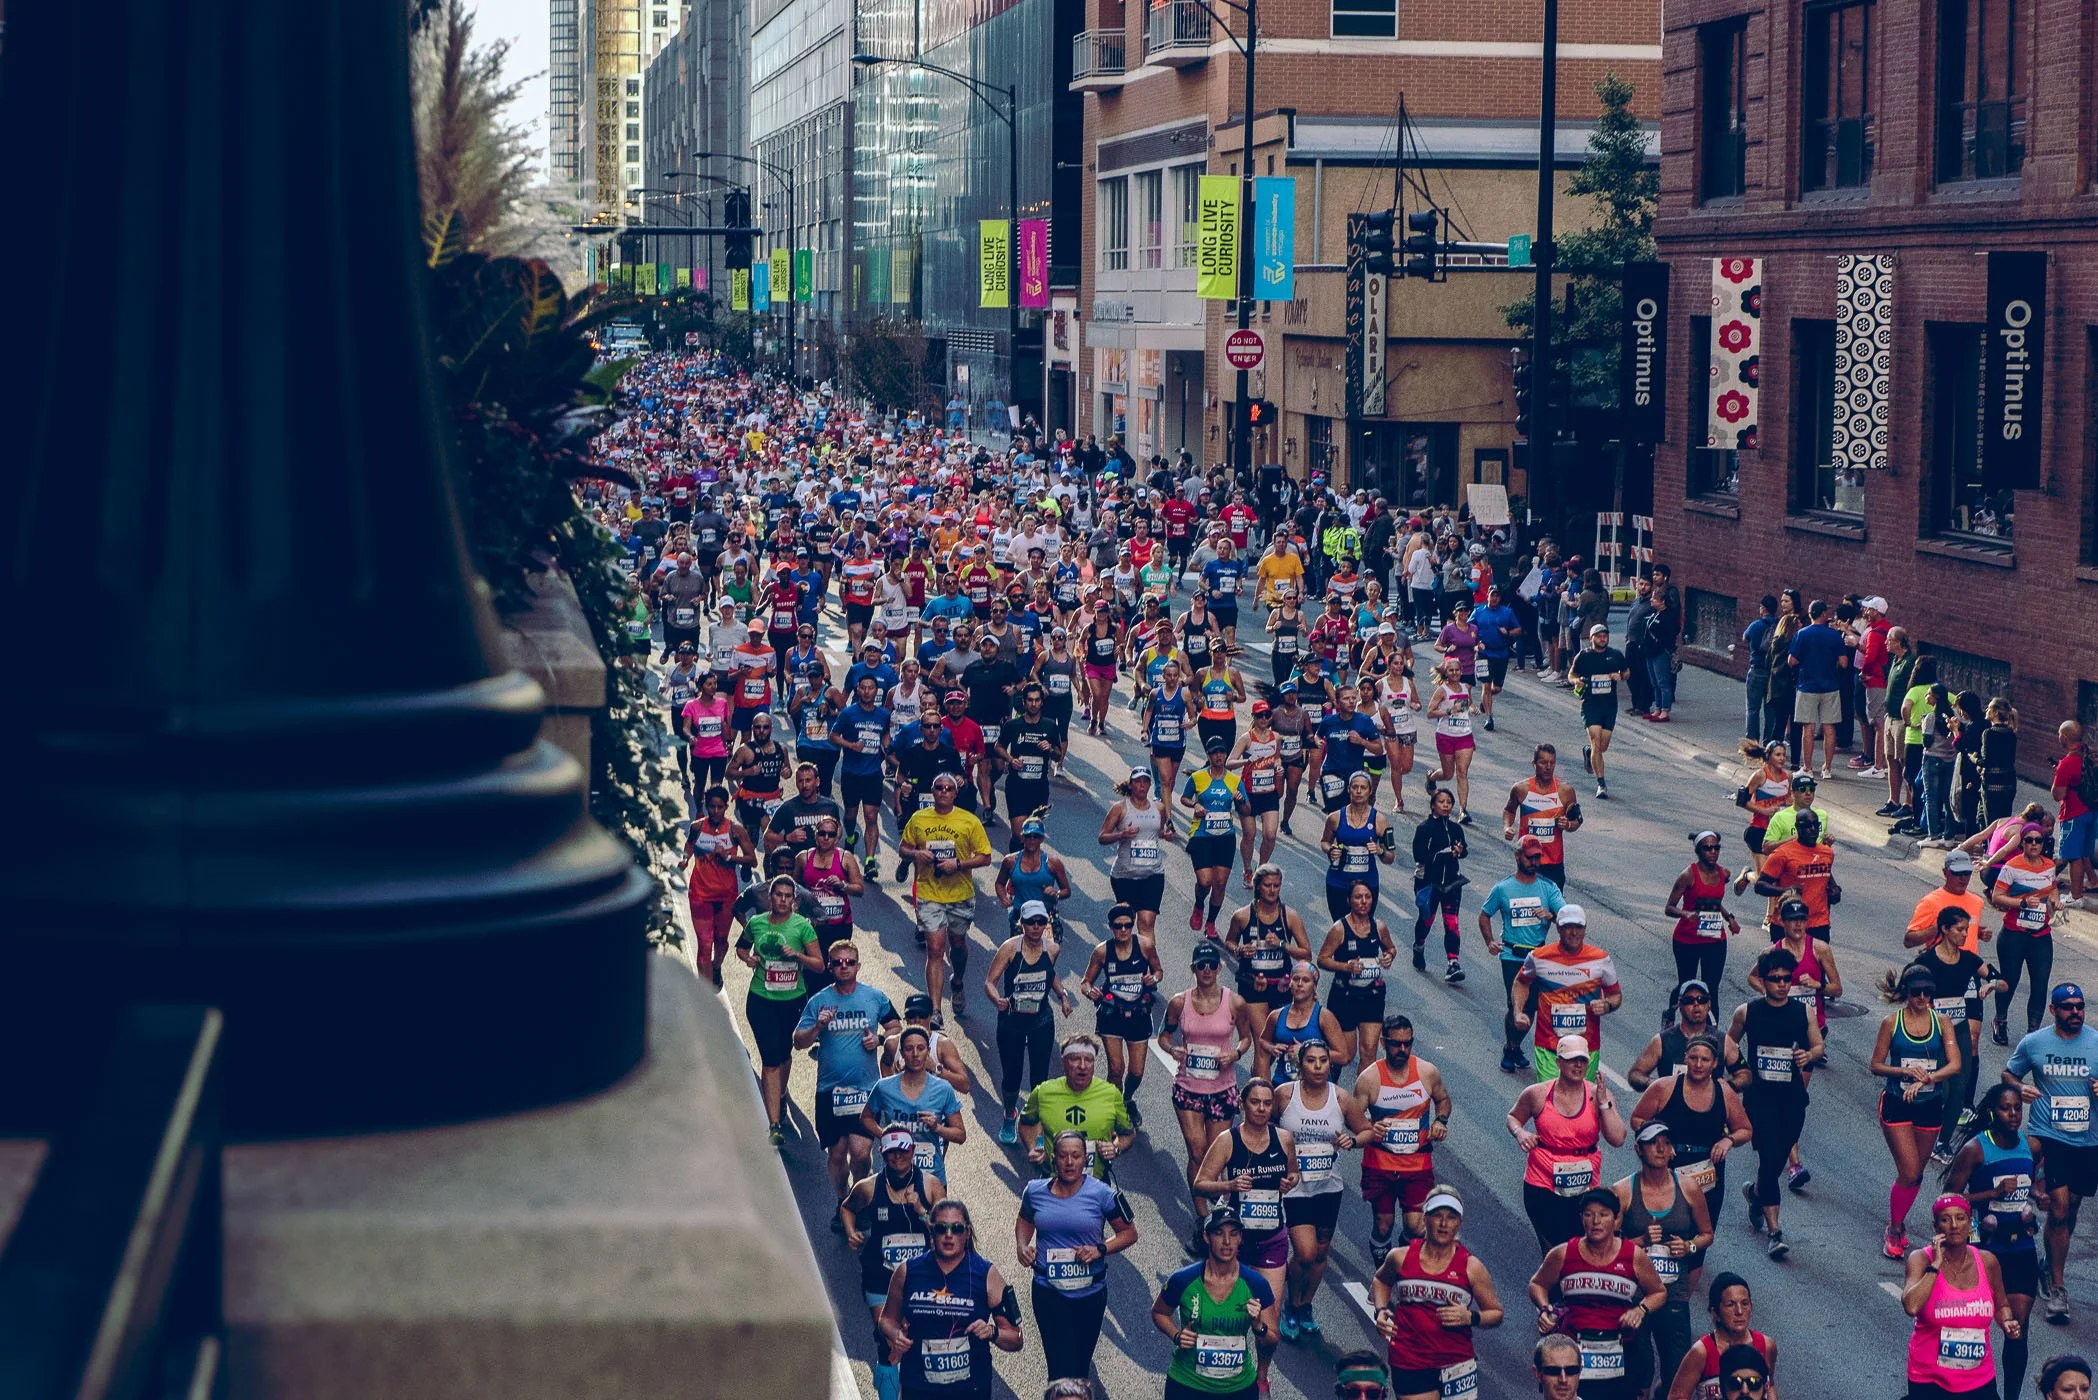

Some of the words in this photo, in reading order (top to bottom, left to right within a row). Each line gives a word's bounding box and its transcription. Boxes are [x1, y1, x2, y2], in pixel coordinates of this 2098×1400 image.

[1203, 199, 1218, 232] LIVE
[1218, 200, 1235, 276] CURIOSITY
[984, 236, 995, 259] LIVE
[1202, 237, 1217, 276] LONG
[995, 237, 1006, 291] CURIOSITY
[984, 261, 995, 292] LONG
[1369, 278, 1380, 373] OLARE
[1231, 337, 1242, 345] DO
[1243, 337, 1257, 345] NOT
[1634, 297, 1658, 407] Optimus
[1232, 355, 1257, 363] ENTER
[2000, 299, 2032, 440] Optimus
[1511, 908, 1517, 918] G
[766, 972, 771, 980] E
[1552, 1016, 1558, 1026] H
[1562, 1016, 1586, 1026] 40173
[1187, 1056, 1192, 1066] G
[1757, 1058, 1763, 1069] G
[2045, 1054, 2087, 1065] Team
[2042, 1064, 2090, 1077] RMHC
[834, 1095, 840, 1105] H
[892, 1109, 918, 1122] Tea
[2052, 1109, 2058, 1120] H
[2063, 1109, 2089, 1121] 42048
[1301, 1118, 1329, 1127] TANYA
[913, 1155, 934, 1168] 1706
[1306, 1157, 1332, 1170] 38693
[1232, 1166, 1255, 1177] FRONT
[1258, 1164, 1286, 1175] RUNNERS
[1555, 1175, 1562, 1186] G
[1566, 1173, 1592, 1187] 32027
[1240, 1203, 1246, 1217] F
[1250, 1204, 1278, 1218] 26995
[884, 1248, 890, 1261] G
[1048, 1264, 1056, 1278] G
[1061, 1263, 1091, 1277] 39091
[1941, 1342, 1949, 1356] G
[1954, 1343, 1985, 1358] 39143
[924, 1356, 932, 1369] G
[937, 1353, 970, 1370] 31603
[1198, 1351, 1206, 1365] G
[1211, 1352, 1244, 1366] 33674
[1590, 1355, 1622, 1368] 33627
[1444, 1383, 1451, 1396] G
